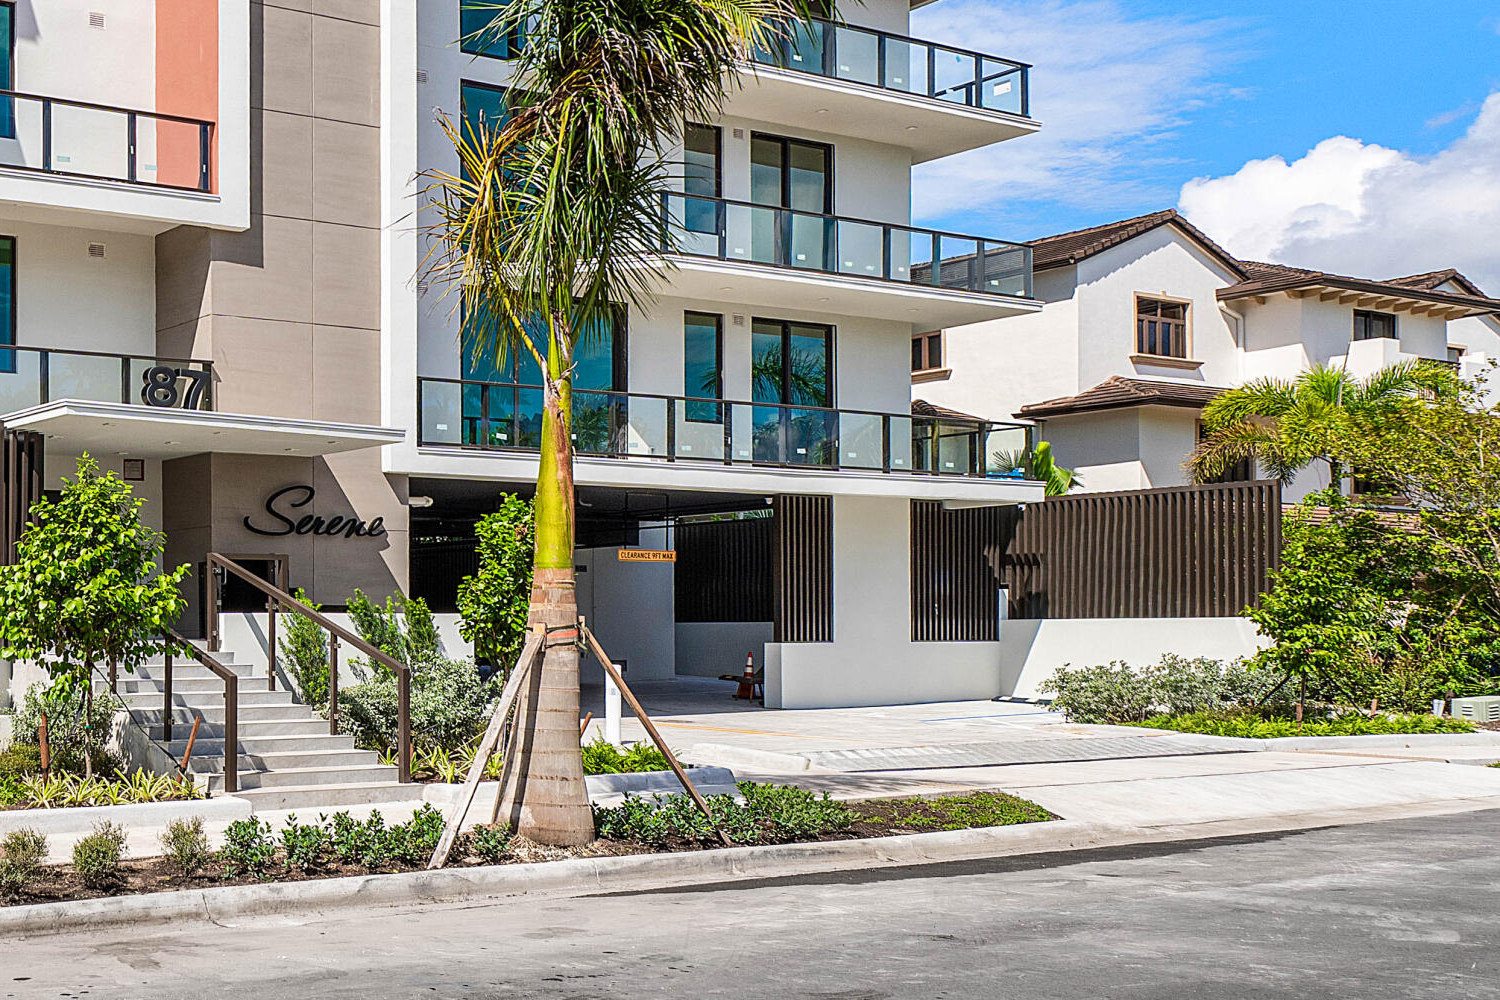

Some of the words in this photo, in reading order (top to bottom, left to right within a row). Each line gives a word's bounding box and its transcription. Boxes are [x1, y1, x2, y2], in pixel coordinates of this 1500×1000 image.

[141, 366, 211, 410] 87
[243, 485, 386, 538] Serene
[620, 551, 651, 559] CLEARANCE
